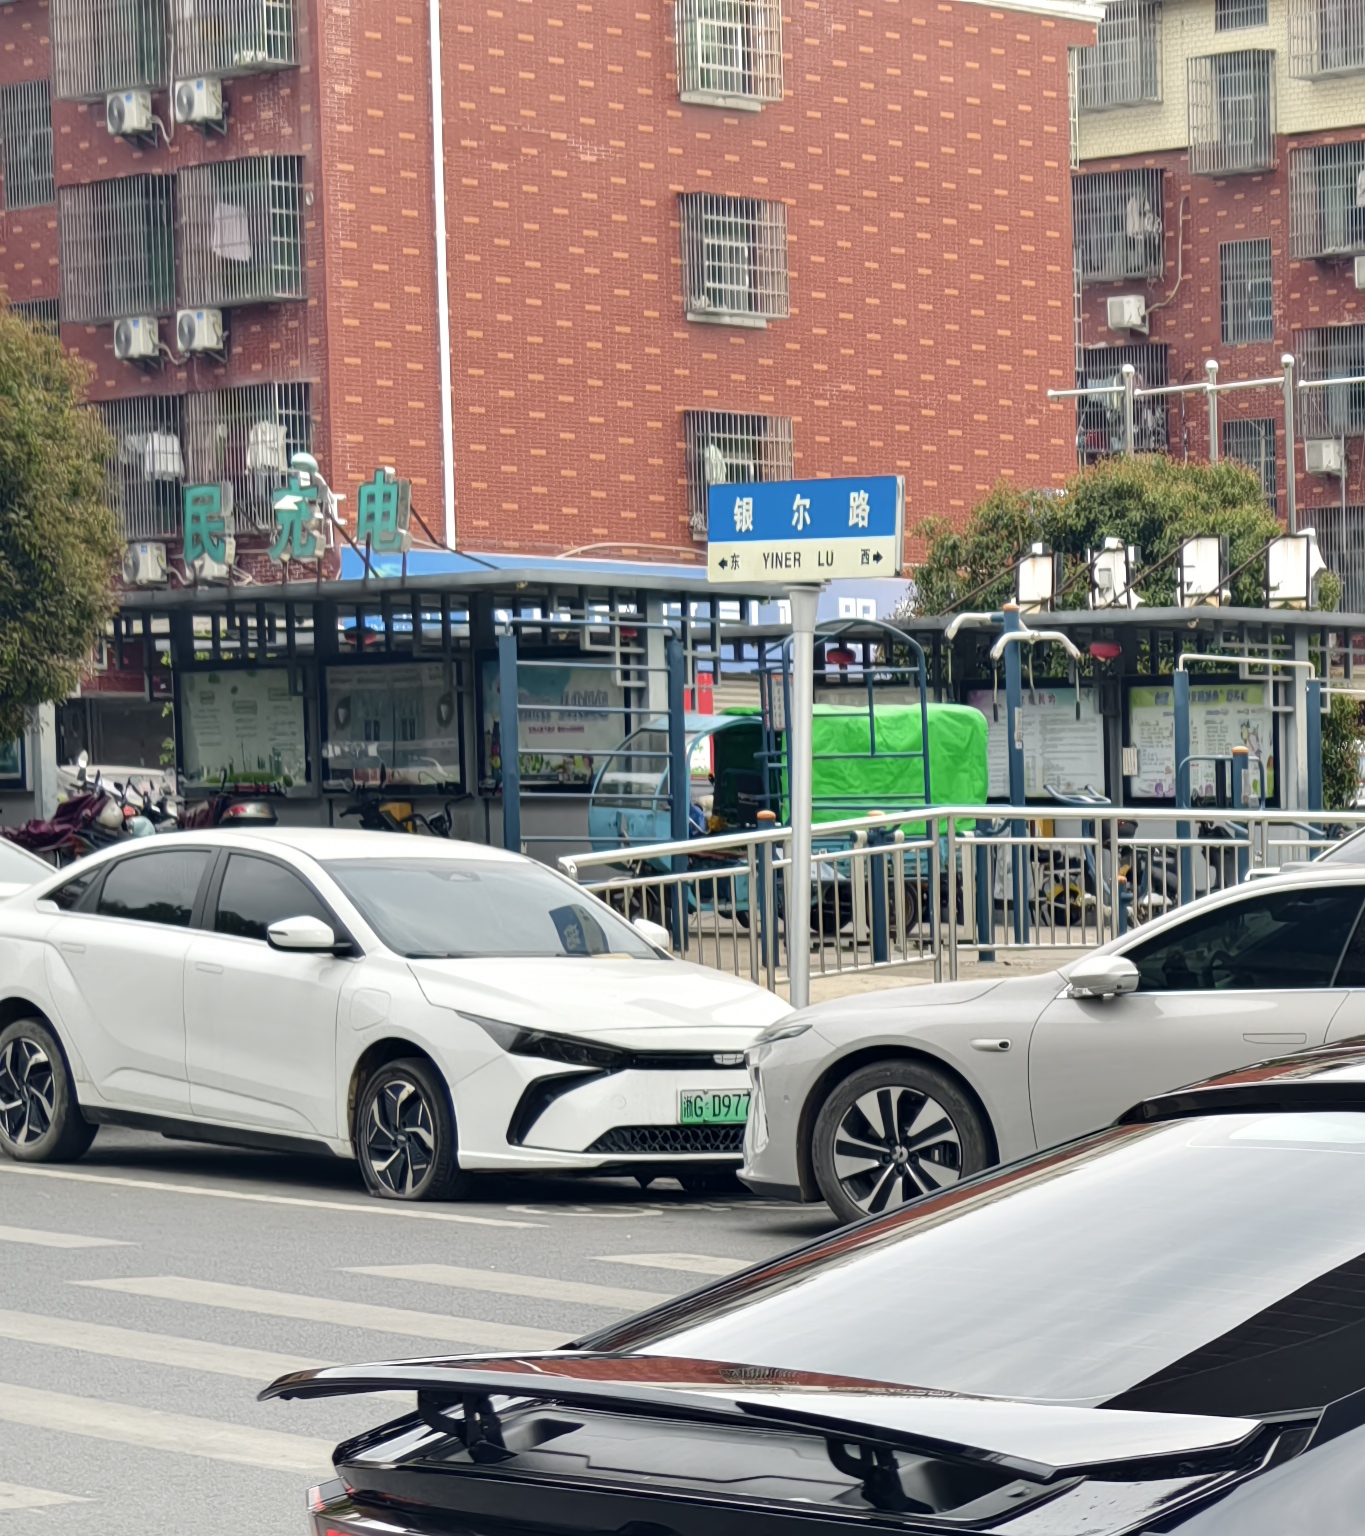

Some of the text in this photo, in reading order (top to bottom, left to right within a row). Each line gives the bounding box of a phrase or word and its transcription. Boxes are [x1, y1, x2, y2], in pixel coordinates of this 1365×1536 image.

[733, 489, 871, 533] 银尔路
[730, 547, 871, 571] 东 YINER LU 西
